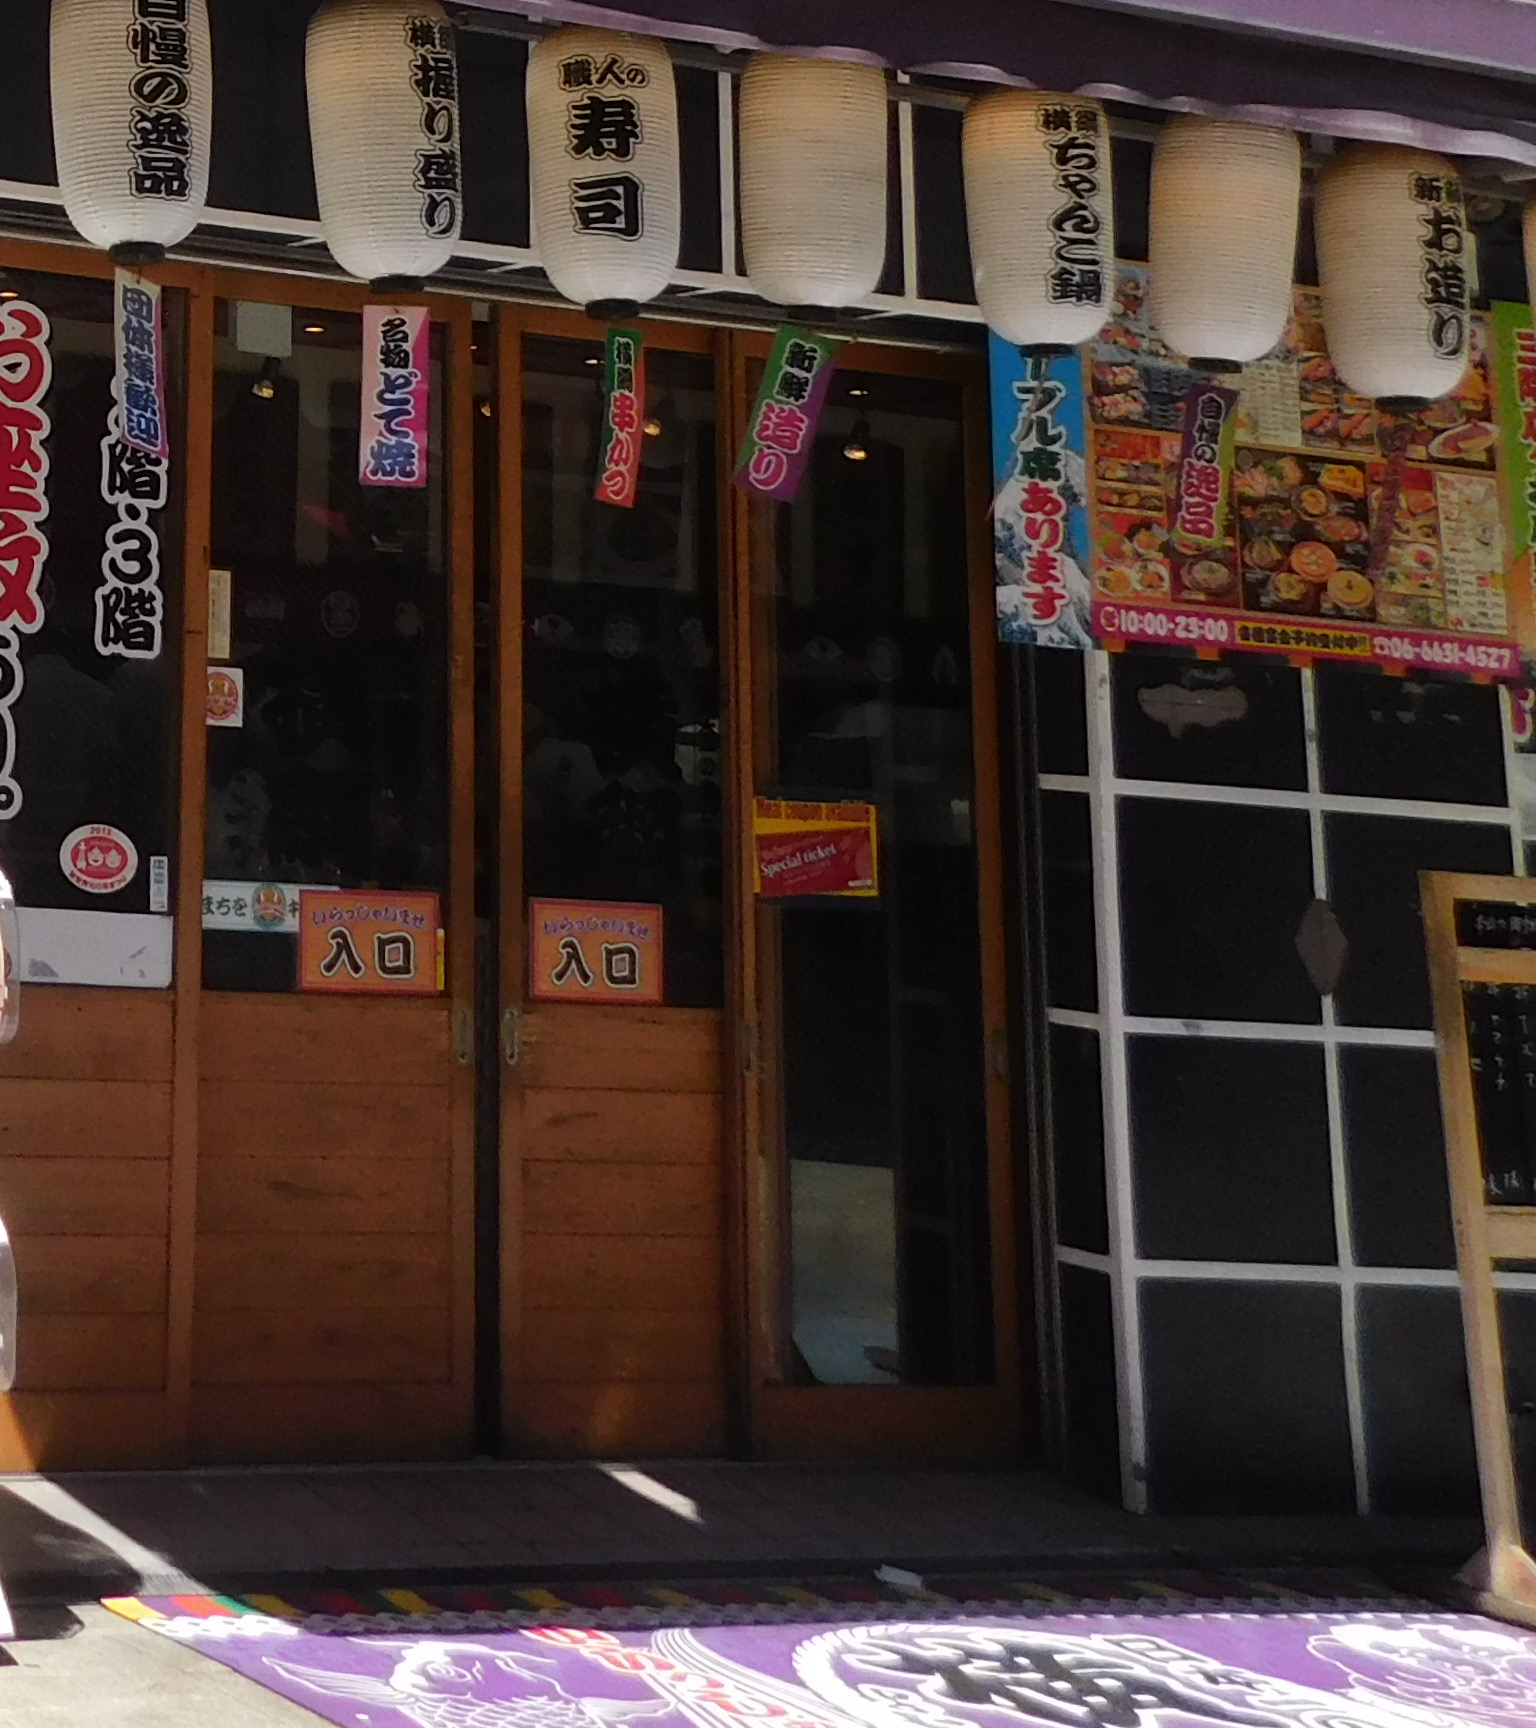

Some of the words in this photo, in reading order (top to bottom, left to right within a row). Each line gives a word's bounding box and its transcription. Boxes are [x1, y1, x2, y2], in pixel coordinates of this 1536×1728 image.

[562, 57, 647, 88] 職人の
[571, 96, 640, 238] 寿司
[1049, 138, 1102, 304] ちゃんこ鍋
[604, 391, 638, 499] 串かつ
[1014, 356, 1070, 621] ーブル席あります
[761, 852, 803, 877] Special
[803, 843, 837, 864] ticket
[312, 906, 425, 928] いらっしゃいませ
[544, 917, 650, 939] いらっしゃいませ
[323, 928, 415, 976] 入口
[553, 938, 639, 986] 入口
